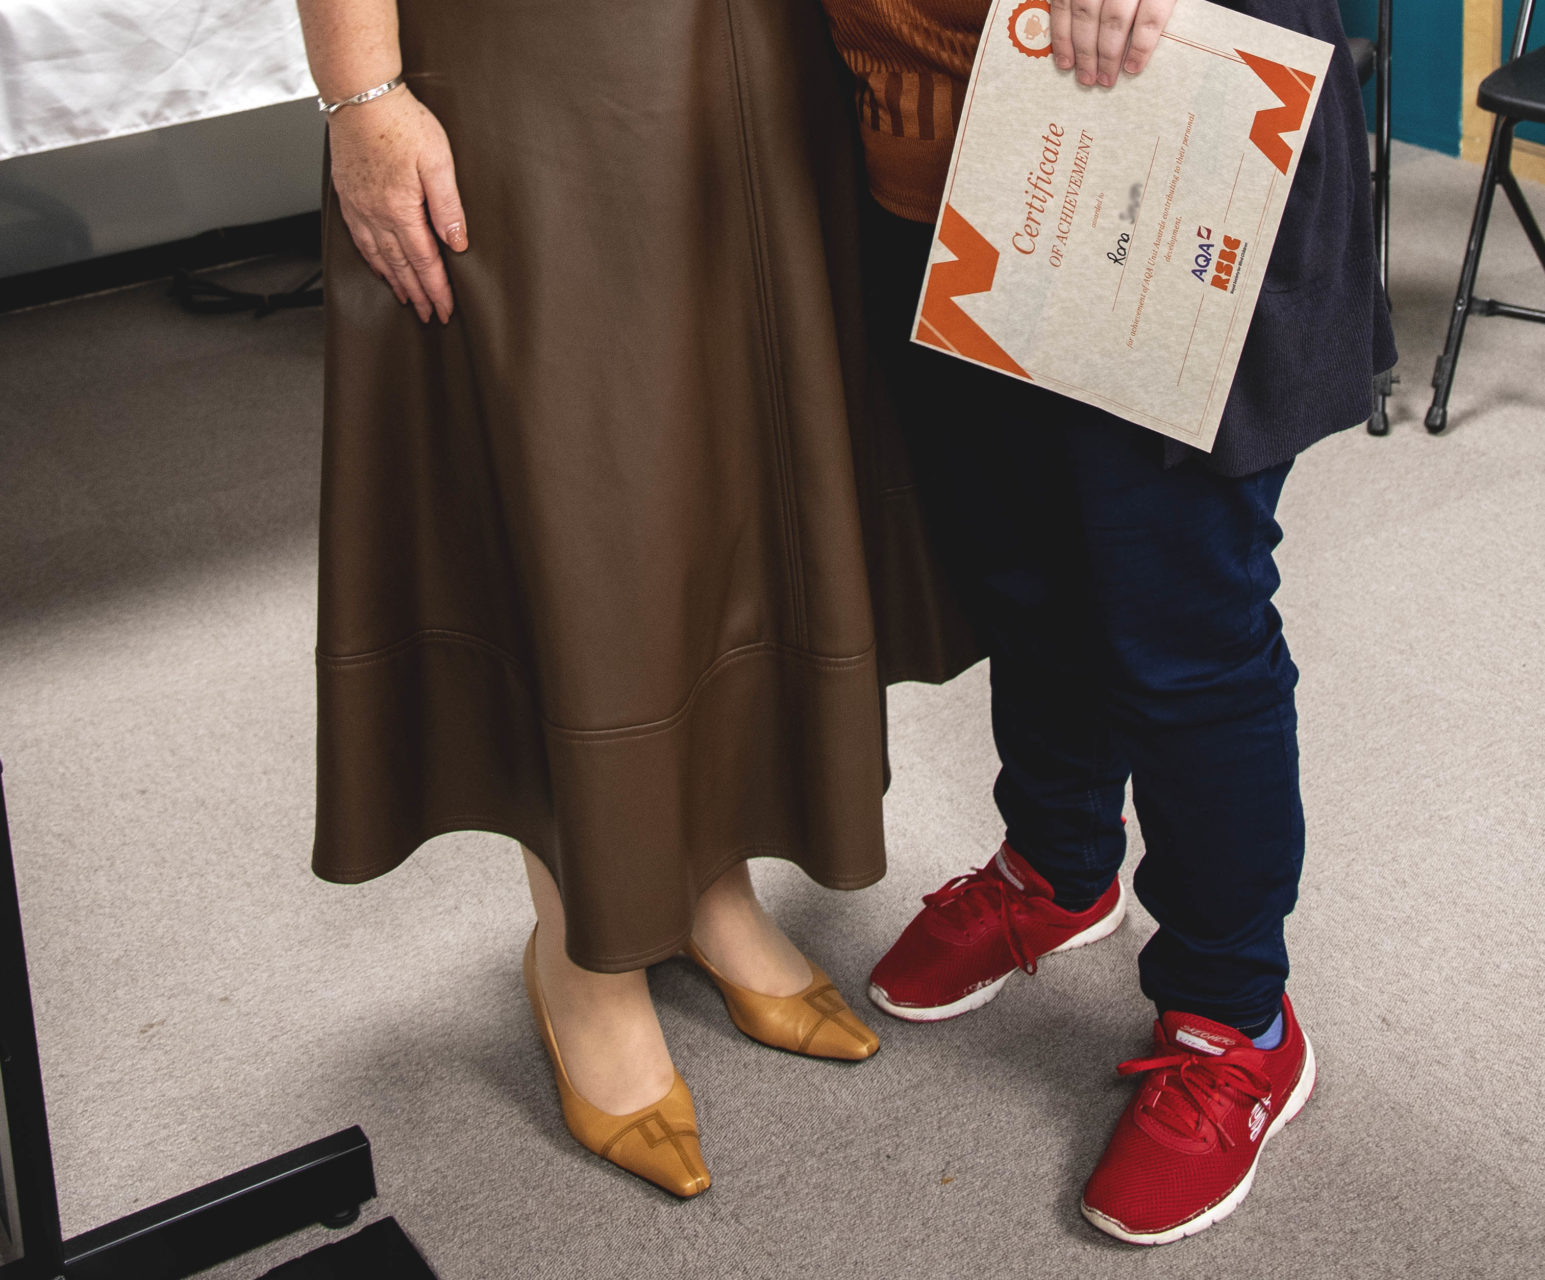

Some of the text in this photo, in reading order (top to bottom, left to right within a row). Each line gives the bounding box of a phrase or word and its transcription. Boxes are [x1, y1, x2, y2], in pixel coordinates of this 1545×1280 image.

[1183, 112, 1195, 147] personal
[1176, 146, 1185, 164] their
[1012, 123, 1064, 255] Certificate
[1049, 129, 1093, 267] OF ACHIEVEMENT
[1161, 175, 1179, 219] contributing
[1091, 199, 1102, 228] awarded
[1153, 221, 1166, 249] Awards
[1164, 217, 1182, 262] development.
[1148, 250, 1157, 266] Unit
[1191, 244, 1214, 282] AQA
[1210, 235, 1241, 291] RSBC
[1142, 284, 1151, 293] of
[1144, 268, 1153, 285] AQA
[1129, 294, 1146, 336] achievement
[1126, 337, 1136, 349] for
